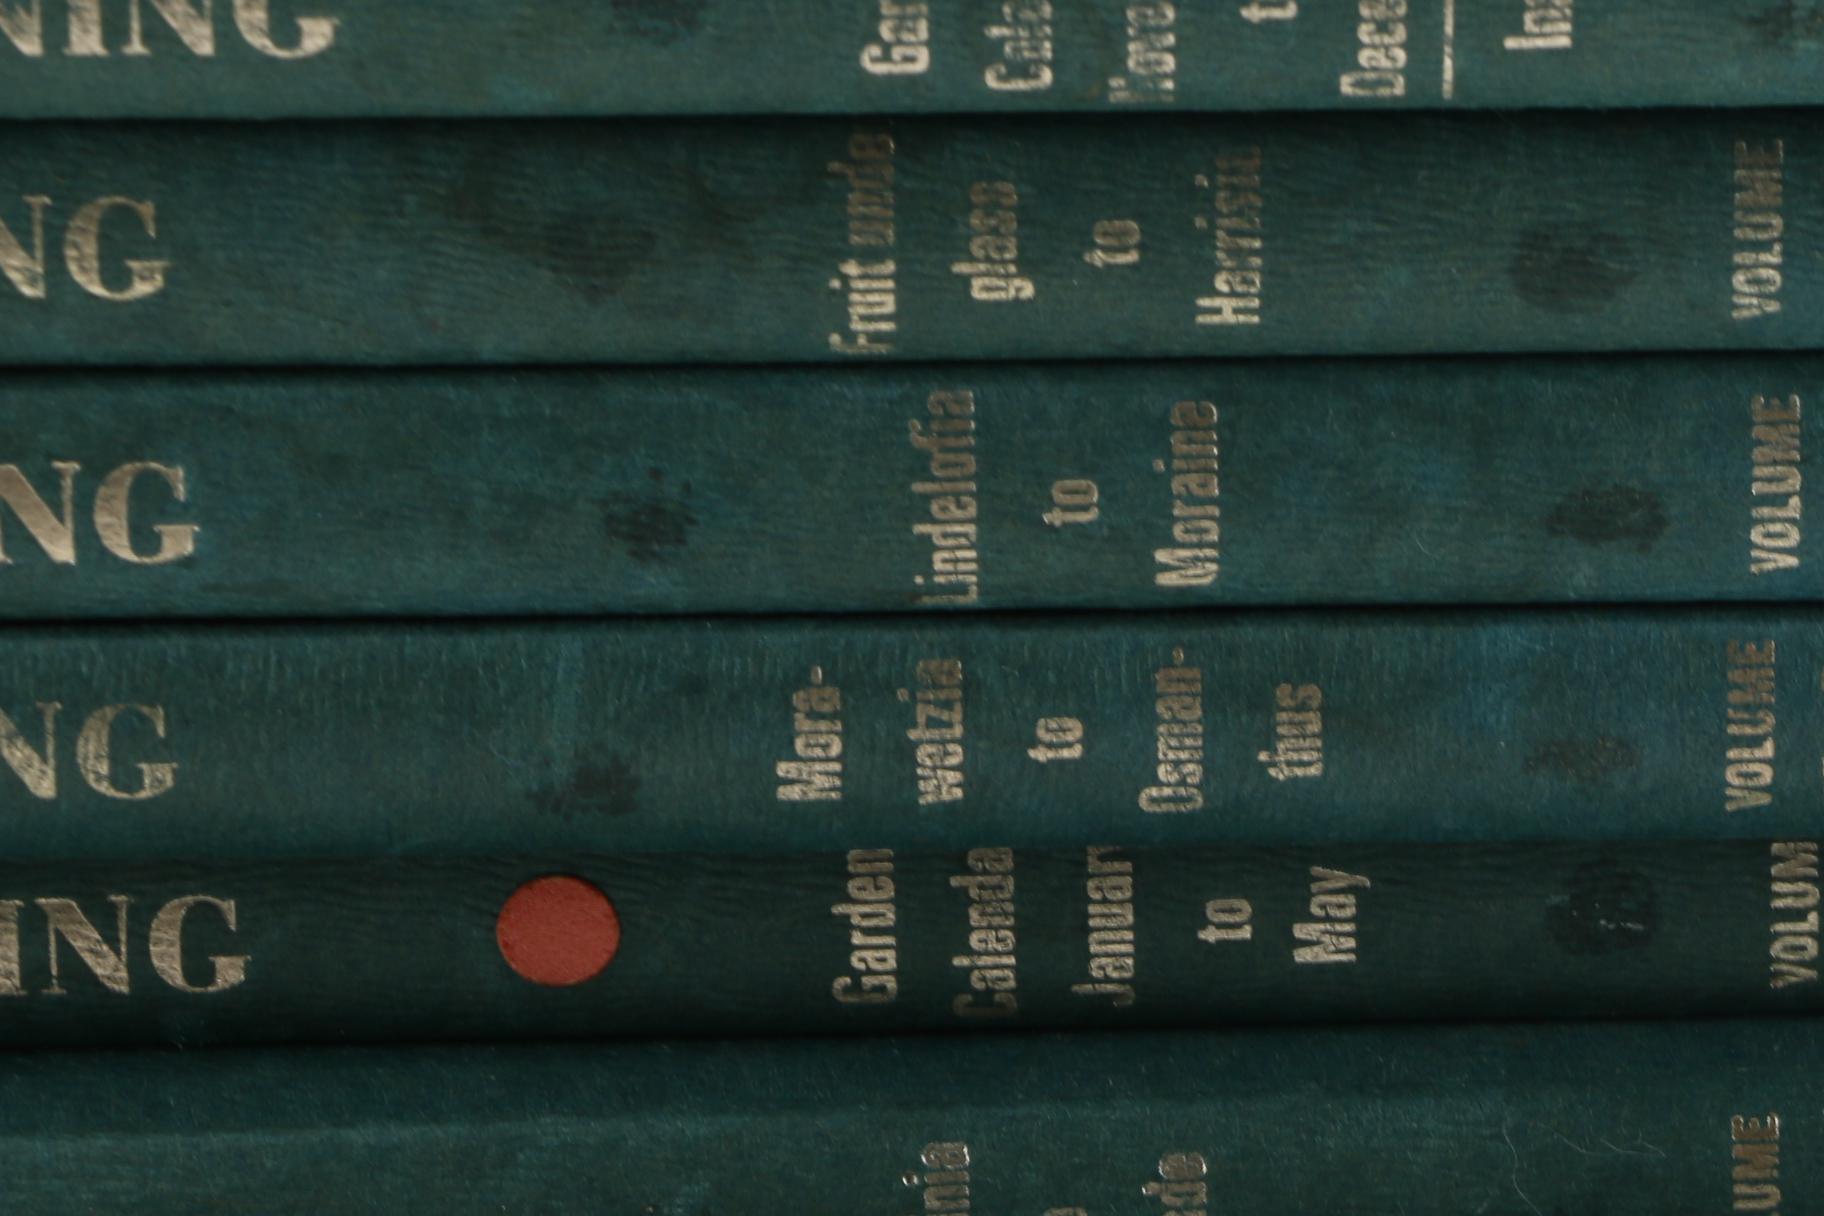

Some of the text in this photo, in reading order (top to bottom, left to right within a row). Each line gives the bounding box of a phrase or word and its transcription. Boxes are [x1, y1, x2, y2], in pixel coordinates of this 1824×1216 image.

[828, 130, 898, 354] Fruit unde
[952, 182, 1036, 302] glass
[1085, 219, 1141, 267] to
[1731, 135, 1785, 319] VOLUME
[908, 390, 980, 603] Lindelofia
[1043, 479, 1100, 527] to
[1153, 400, 1221, 587] Moraine
[1750, 393, 1803, 574] VOLUME
[775, 667, 845, 800] Mora-
[897, 660, 966, 804] wetzia
[1028, 716, 1085, 763] to
[1138, 647, 1206, 812] Osman-
[1258, 682, 1325, 780] thus
[1725, 641, 1777, 811] VOLUME
[833, 850, 898, 1003] Garden
[1073, 845, 1136, 1006] Januar
[1199, 897, 1254, 942] to
[1292, 866, 1369, 962] May
